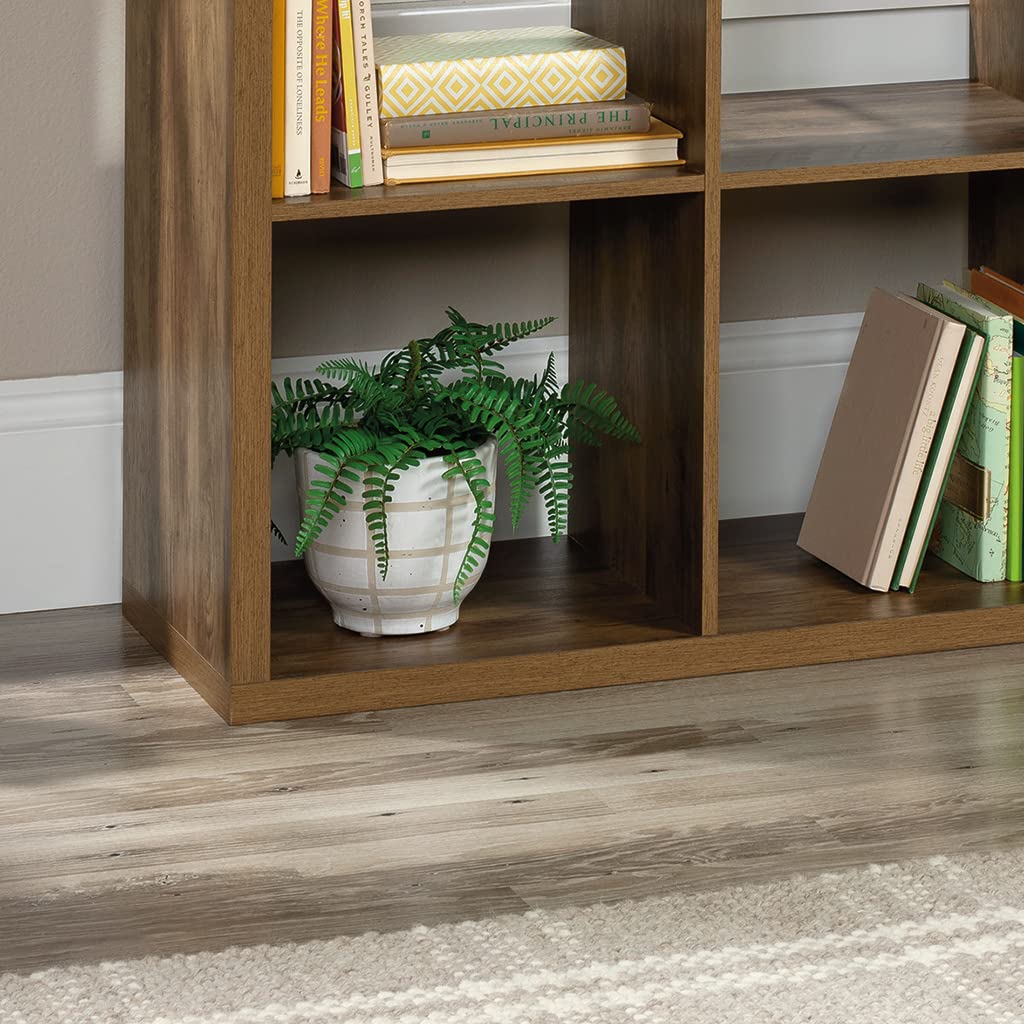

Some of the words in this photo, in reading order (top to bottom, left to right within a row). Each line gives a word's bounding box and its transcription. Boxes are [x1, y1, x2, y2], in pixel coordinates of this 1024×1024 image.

[296, 10, 304, 28] THE
[341, 10, 351, 21] It!
[361, 34, 370, 70] TALES
[315, 54, 328, 76] He
[296, 71, 303, 84] OF
[295, 85, 303, 136] LONELINESS
[314, 80, 328, 123] Leads
[364, 84, 374, 129] GULLEY
[489, 111, 588, 130] PRINCIPAL
[596, 109, 632, 123] THE
